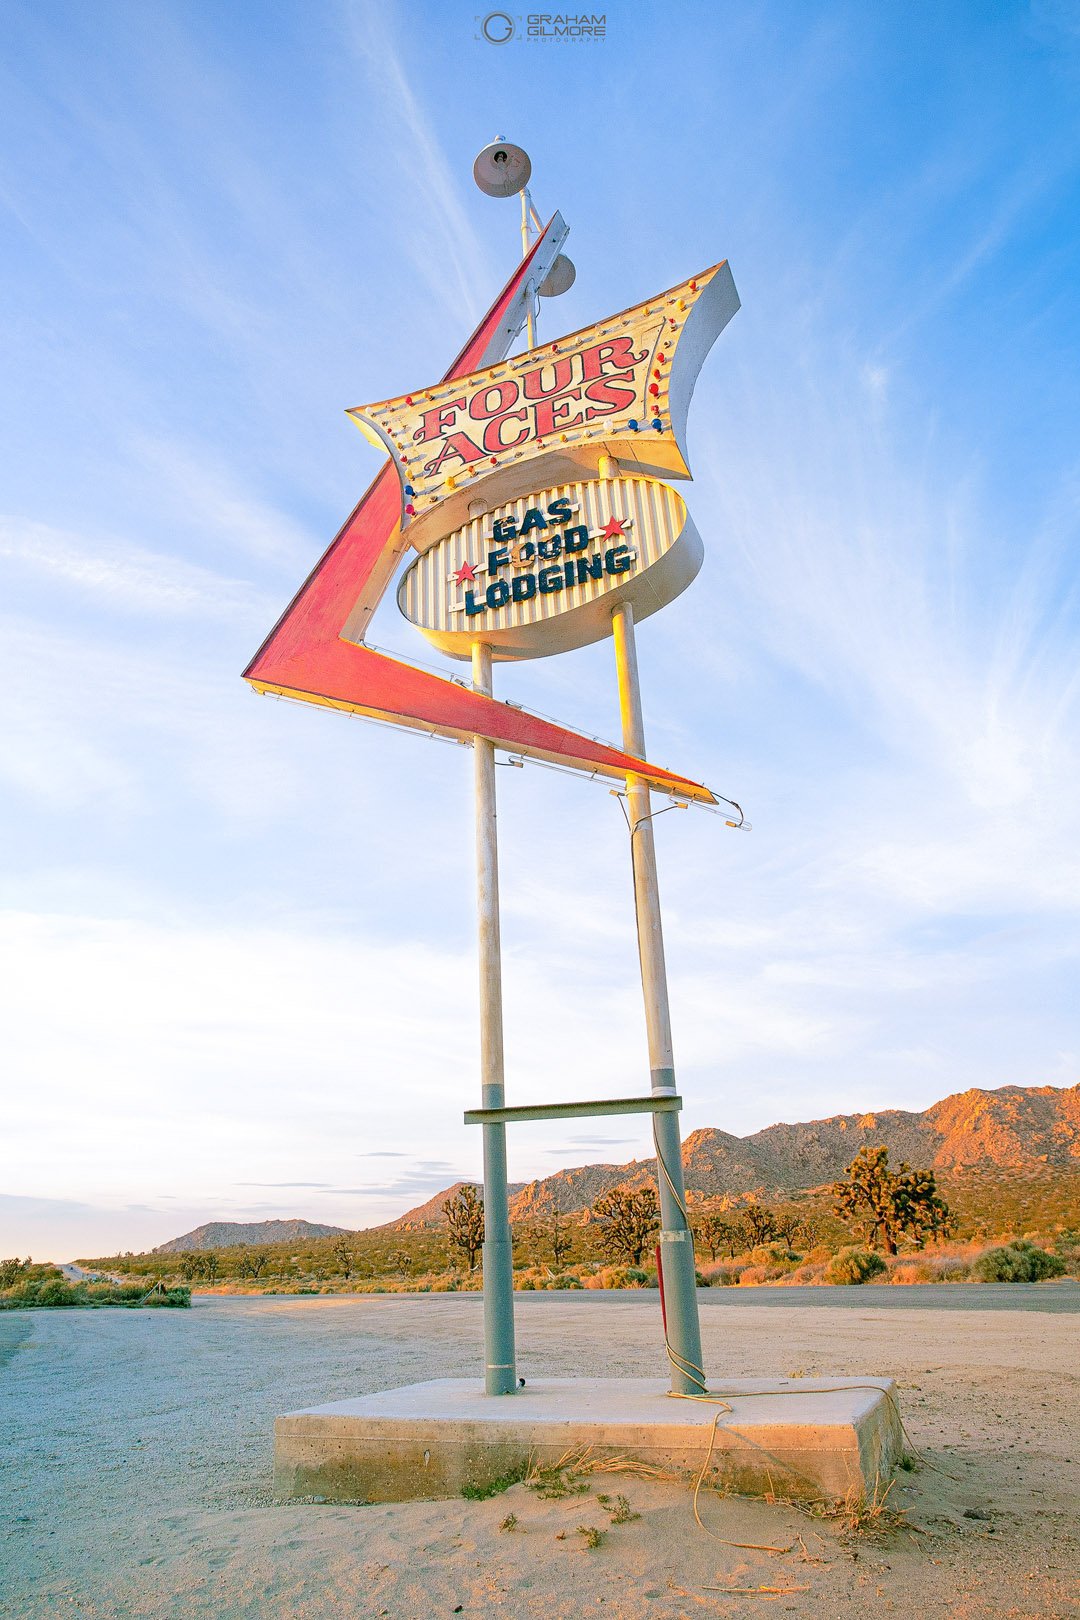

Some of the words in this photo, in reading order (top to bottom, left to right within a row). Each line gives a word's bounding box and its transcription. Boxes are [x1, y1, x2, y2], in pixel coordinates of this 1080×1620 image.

[413, 336, 649, 445] FOUR
[423, 368, 636, 479] ACES
[488, 524, 589, 577] FOOD
[492, 497, 573, 544] GAS
[464, 544, 632, 617] LODGING
